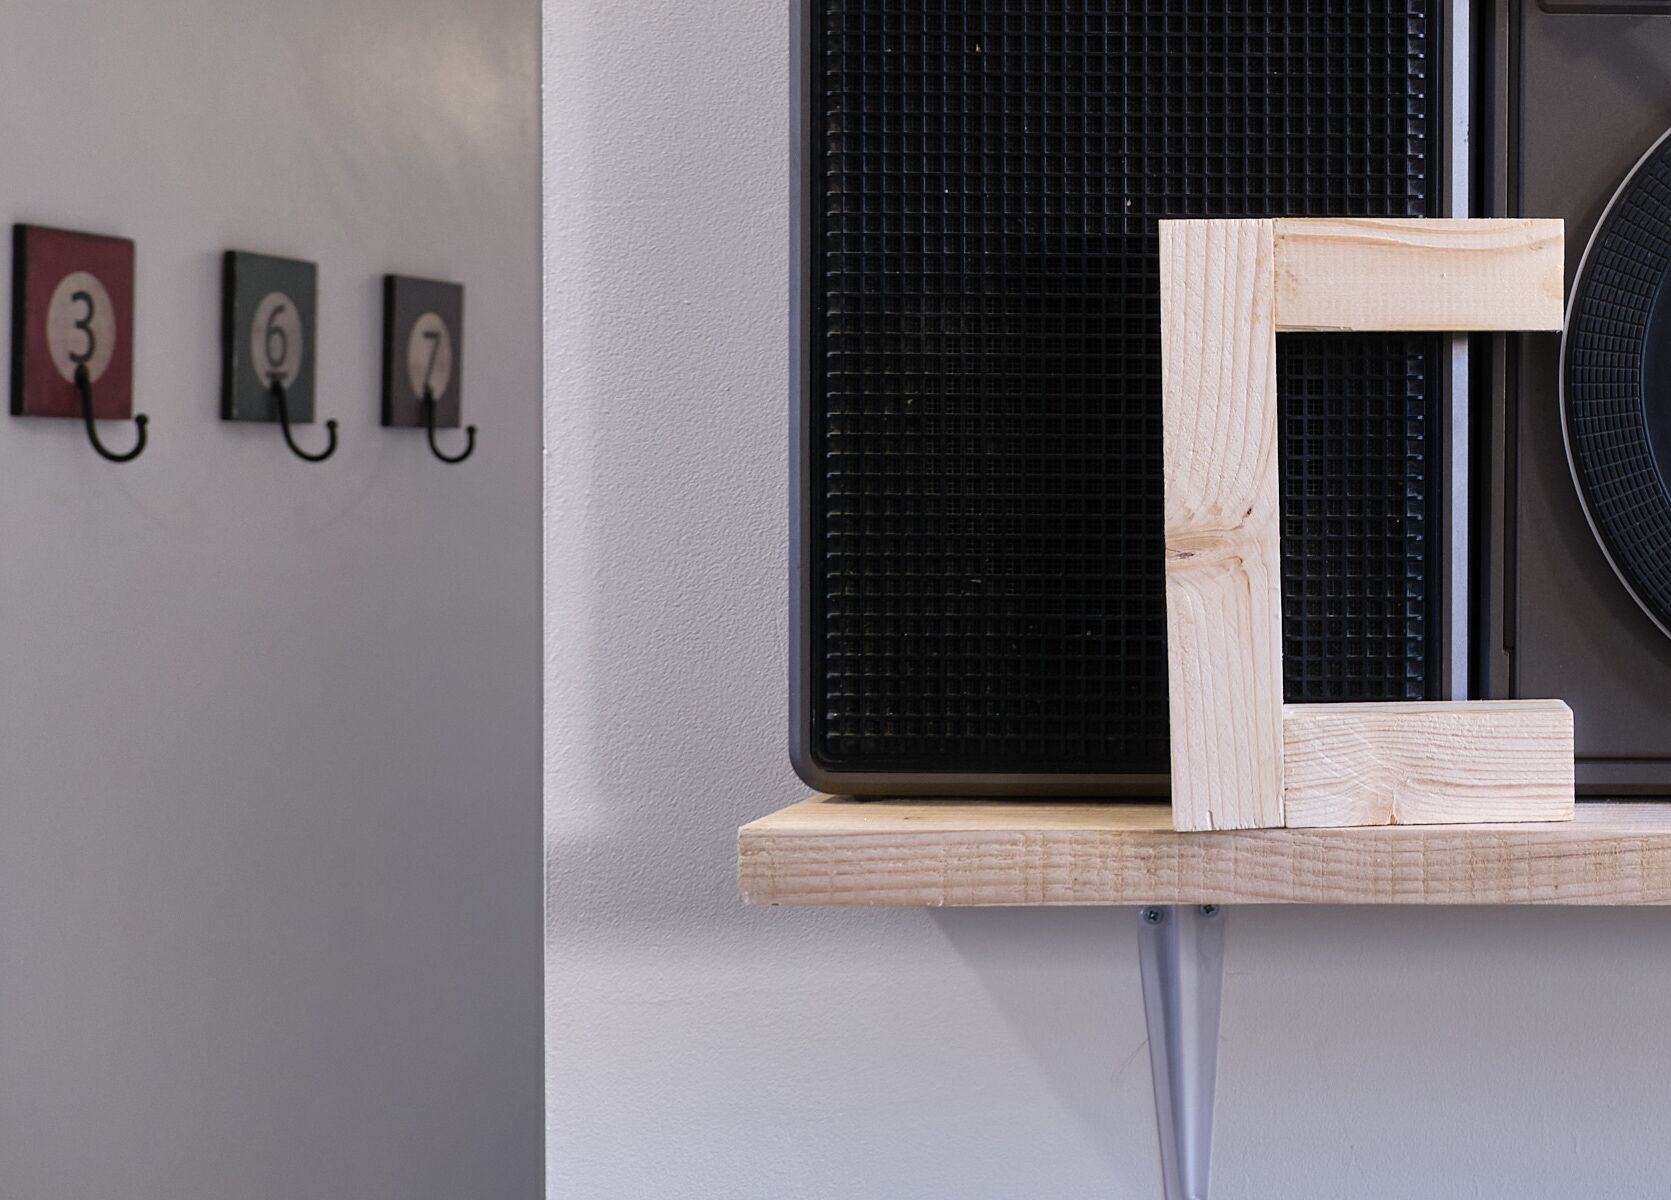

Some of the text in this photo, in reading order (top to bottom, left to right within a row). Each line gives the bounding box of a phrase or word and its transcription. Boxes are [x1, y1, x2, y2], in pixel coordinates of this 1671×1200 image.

[69, 290, 96, 364] 3
[265, 304, 289, 369] 6
[423, 330, 442, 388] 7
